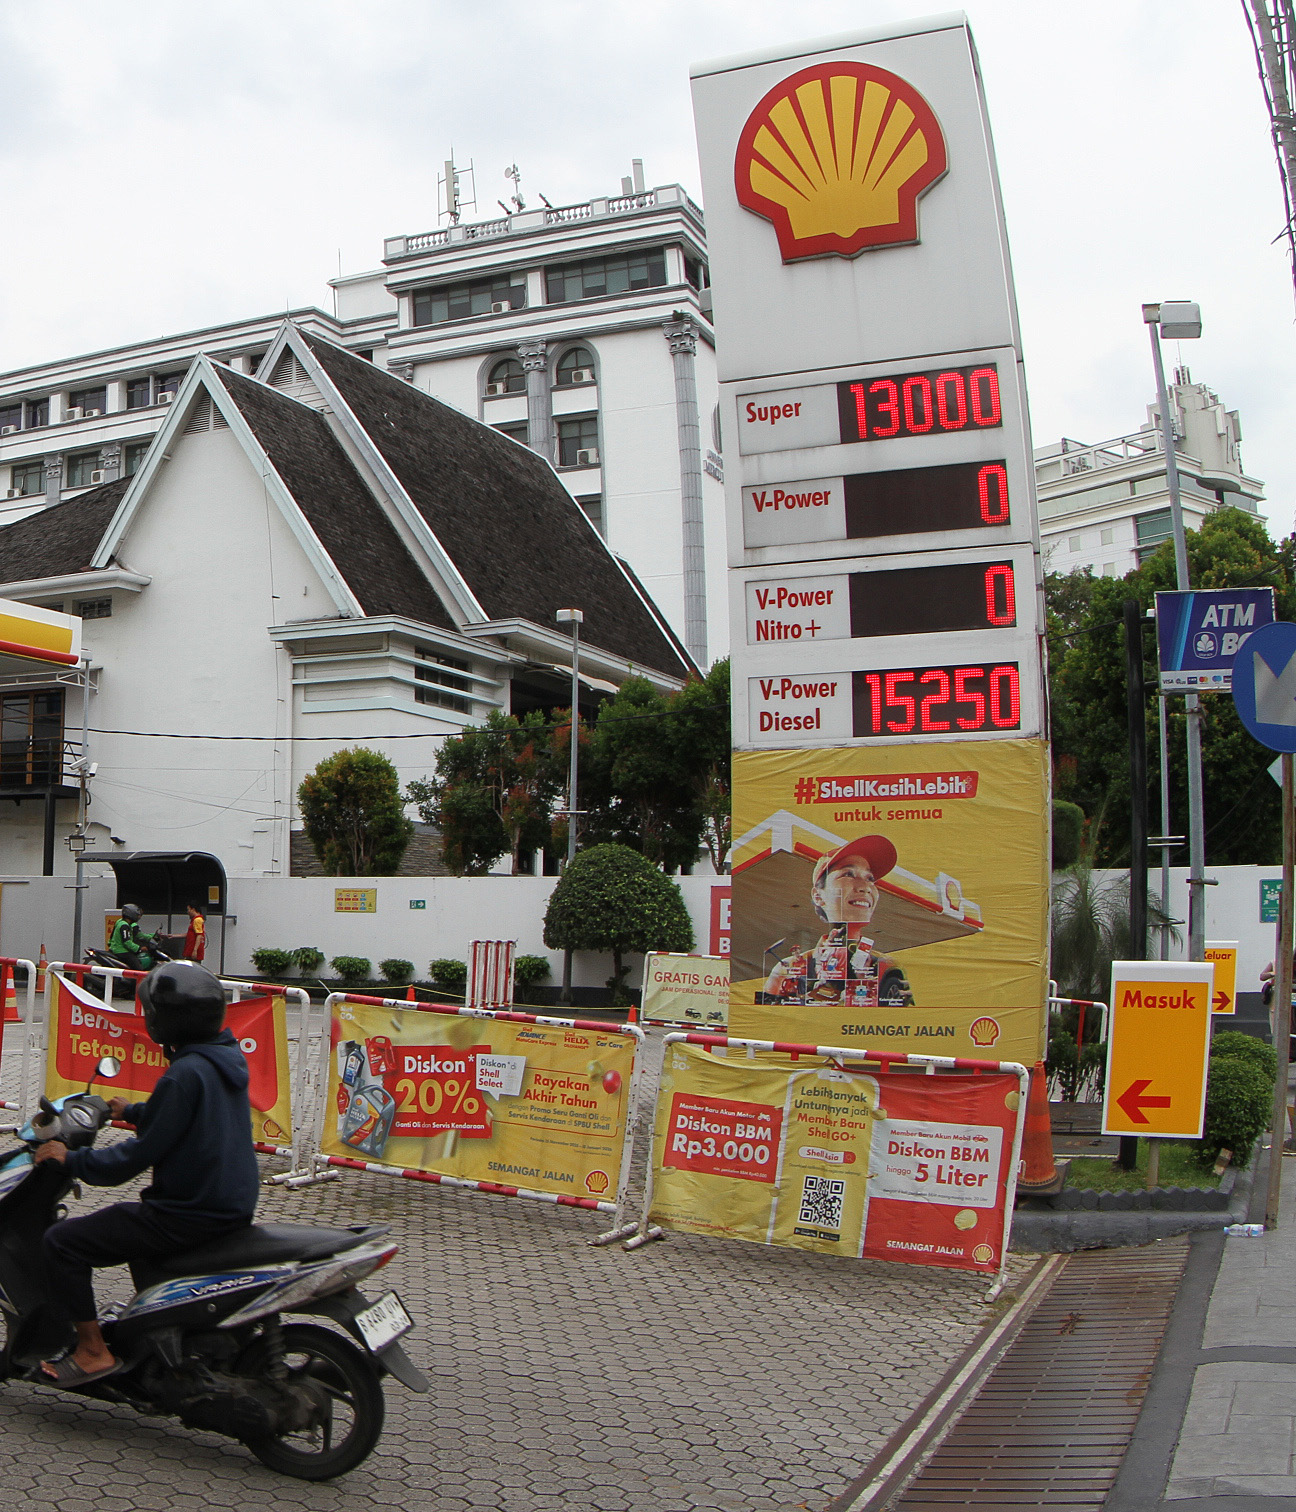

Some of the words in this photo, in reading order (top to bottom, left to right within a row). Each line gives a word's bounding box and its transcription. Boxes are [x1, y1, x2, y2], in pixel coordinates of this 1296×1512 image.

[746, 400, 802, 425] Super
[850, 368, 1002, 439] 13000
[752, 488, 832, 512] V-Power
[978, 465, 1010, 523] 0
[755, 588, 834, 610] V-Power
[984, 565, 1016, 626] 0
[1201, 603, 1256, 628] ATM
[759, 678, 838, 701] V-Power
[865, 666, 1021, 733] 15250
[759, 708, 821, 732] Diesel
[834, 806, 882, 822] untuk
[887, 808, 943, 821] semua
[654, 971, 700, 985] GRATIS
[703, 975, 730, 987] GAN
[1122, 989, 1197, 1010] Masuk
[70, 1005, 129, 1038] Beng
[841, 1024, 911, 1038] SEMANGAT
[914, 1024, 955, 1038] JALAN
[69, 1033, 126, 1060] Tetap
[132, 1043, 171, 1068] Buk
[564, 1036, 590, 1045] HELIX
[478, 1078, 503, 1088] Select
[479, 1068, 500, 1078] Shell
[534, 1073, 590, 1092] Rayakan
[395, 1079, 480, 1115] 20%
[523, 1088, 558, 1104] Akhir
[560, 1093, 598, 1109] Tahun
[801, 1086, 830, 1097] Lebih
[508, 1103, 529, 1111] dengan
[530, 1105, 552, 1114] Promo
[552, 1108, 568, 1116] Seru
[569, 1110, 588, 1118] Ganti
[508, 1111, 529, 1120] Servis
[529, 1113, 566, 1125] Kendaraan
[573, 1120, 592, 1129] SPBU
[593, 1122, 610, 1130] Shell
[679, 1102, 704, 1111] Member
[704, 1106, 719, 1114] Baru
[720, 1109, 736, 1117] Akun
[736, 1111, 755, 1119] Motor
[851, 1106, 869, 1117] jadi
[451, 1122, 485, 1130] Kendaraan
[676, 1114, 731, 1136] Diskon
[735, 1123, 772, 1141] BBM
[840, 1118, 866, 1129] Baru
[832, 1131, 856, 1141] GO+
[672, 1133, 770, 1165] Rp3.000
[806, 1149, 824, 1157] Shell
[888, 1141, 945, 1159] Diskon
[951, 1146, 989, 1163] BBM
[487, 1161, 540, 1178] SEMANGAT
[542, 1170, 574, 1183] JALAN
[886, 1165, 911, 1176] hingga
[915, 1163, 929, 1183] 5
[936, 1164, 988, 1187] Liter
[886, 1240, 934, 1253] SEMANGAT
[935, 1245, 964, 1256] JALAN
[189, 1275, 256, 1296] VARIO
